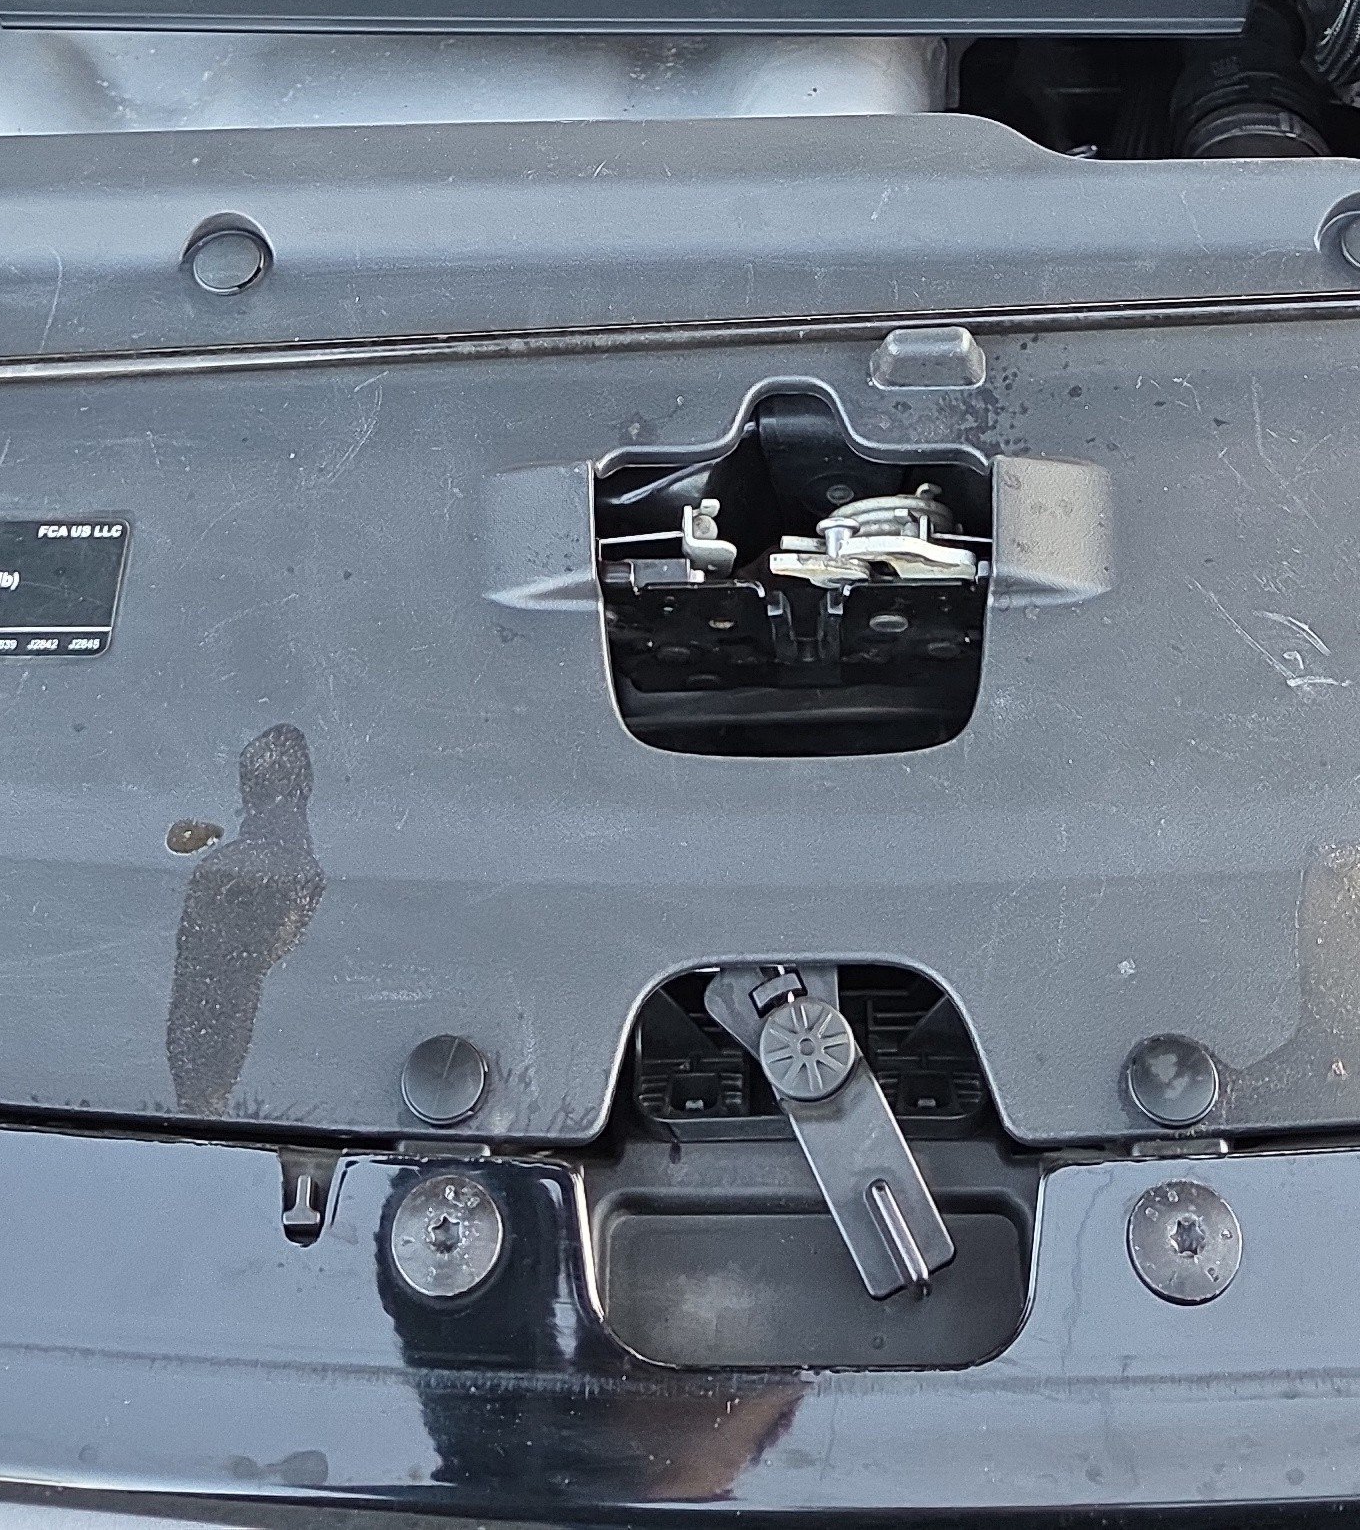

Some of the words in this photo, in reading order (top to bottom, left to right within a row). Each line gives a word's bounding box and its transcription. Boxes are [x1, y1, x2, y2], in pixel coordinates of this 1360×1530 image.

[37, 523, 69, 538] FCA
[70, 523, 89, 538] US
[90, 523, 123, 538] LLC
